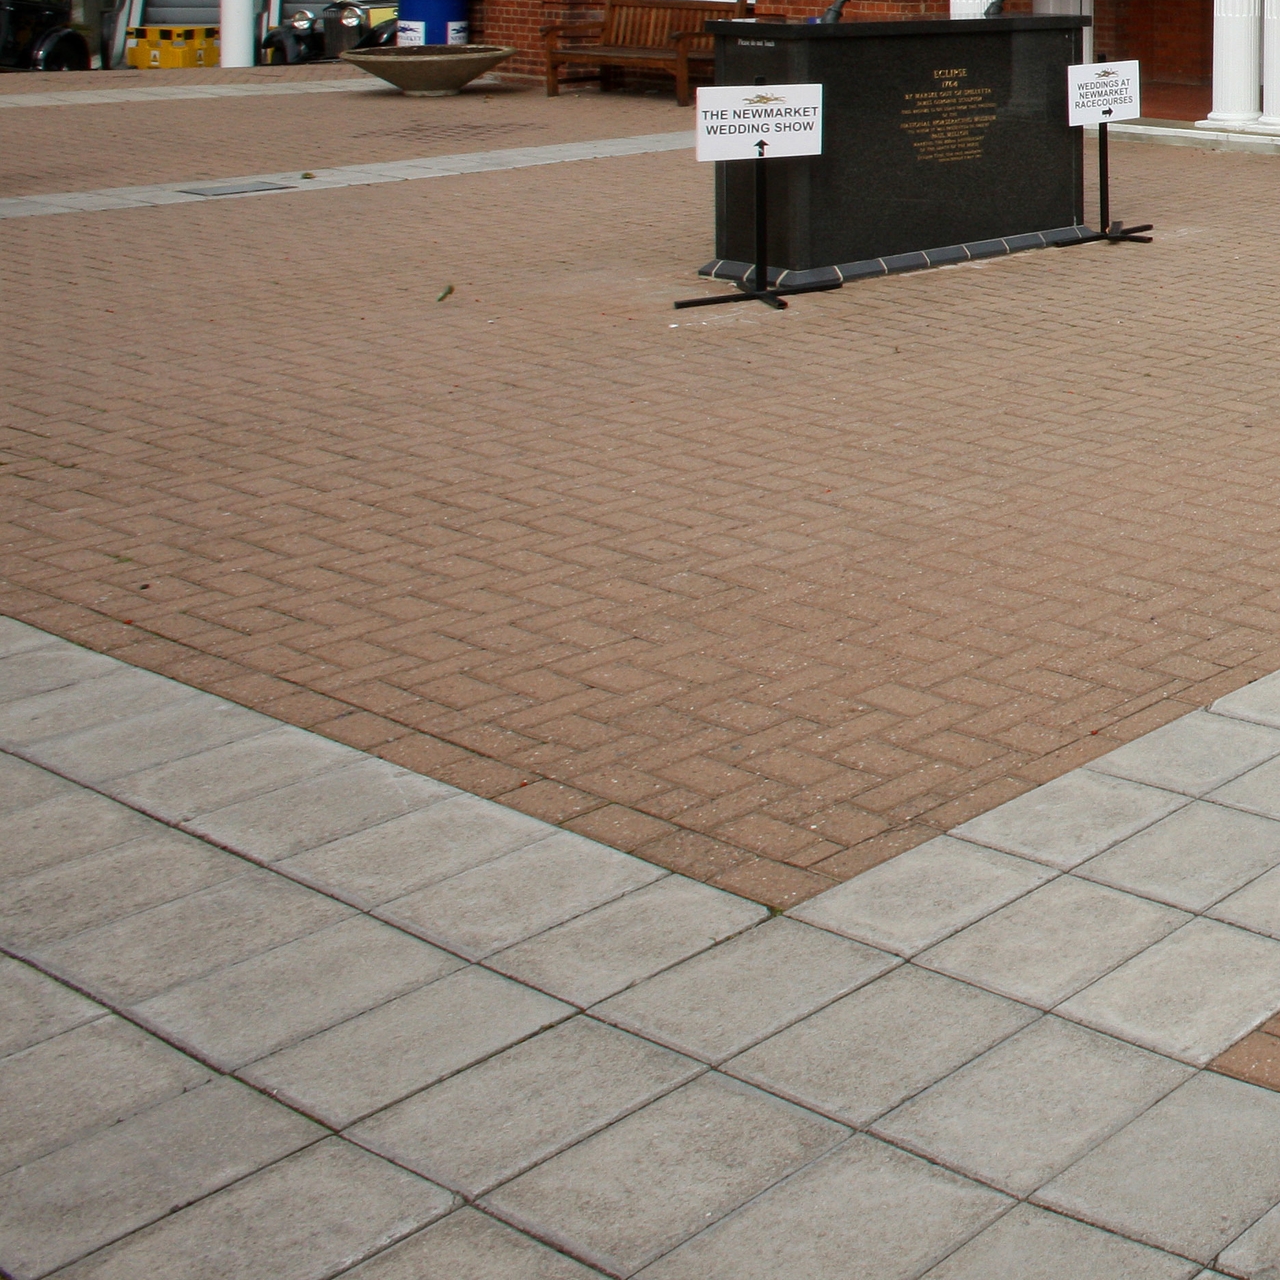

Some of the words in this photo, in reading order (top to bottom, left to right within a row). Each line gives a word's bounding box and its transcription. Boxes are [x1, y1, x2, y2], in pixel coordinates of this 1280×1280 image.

[933, 68, 968, 79] ECLIPSE
[1077, 80, 1119, 91] WEDDINGS
[1121, 78, 1131, 87] AT
[1079, 88, 1129, 100] NEWMARKET
[1075, 96, 1133, 109] RACECOURSES
[702, 110, 728, 120] THE
[732, 106, 819, 119] NEWMARKET
[706, 123, 770, 135] WEDDING
[774, 121, 815, 133] SHOW
